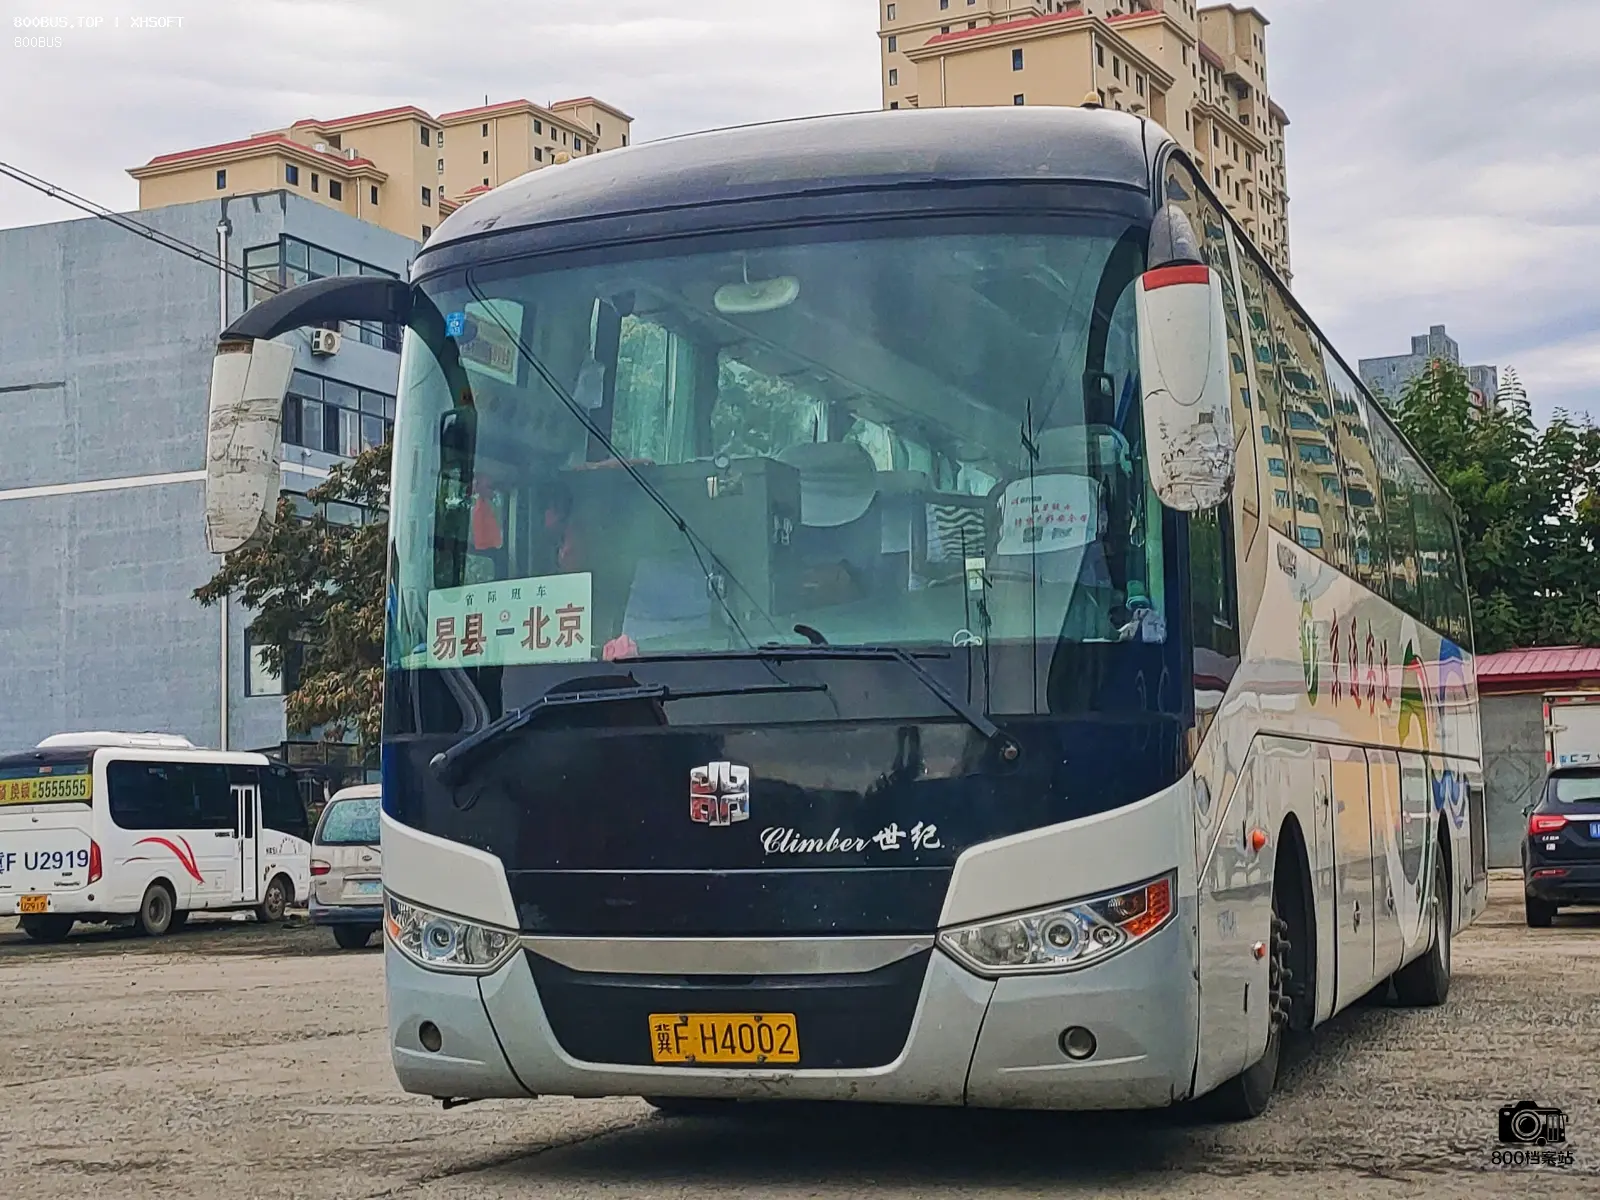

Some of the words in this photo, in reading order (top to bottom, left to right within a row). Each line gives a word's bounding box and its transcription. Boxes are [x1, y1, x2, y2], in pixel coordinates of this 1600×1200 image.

[38, 778, 87, 799] 5555555
[760, 826, 872, 855] Climber
[872, 821, 941, 850] 世纪
[24, 849, 89, 871] U2919
